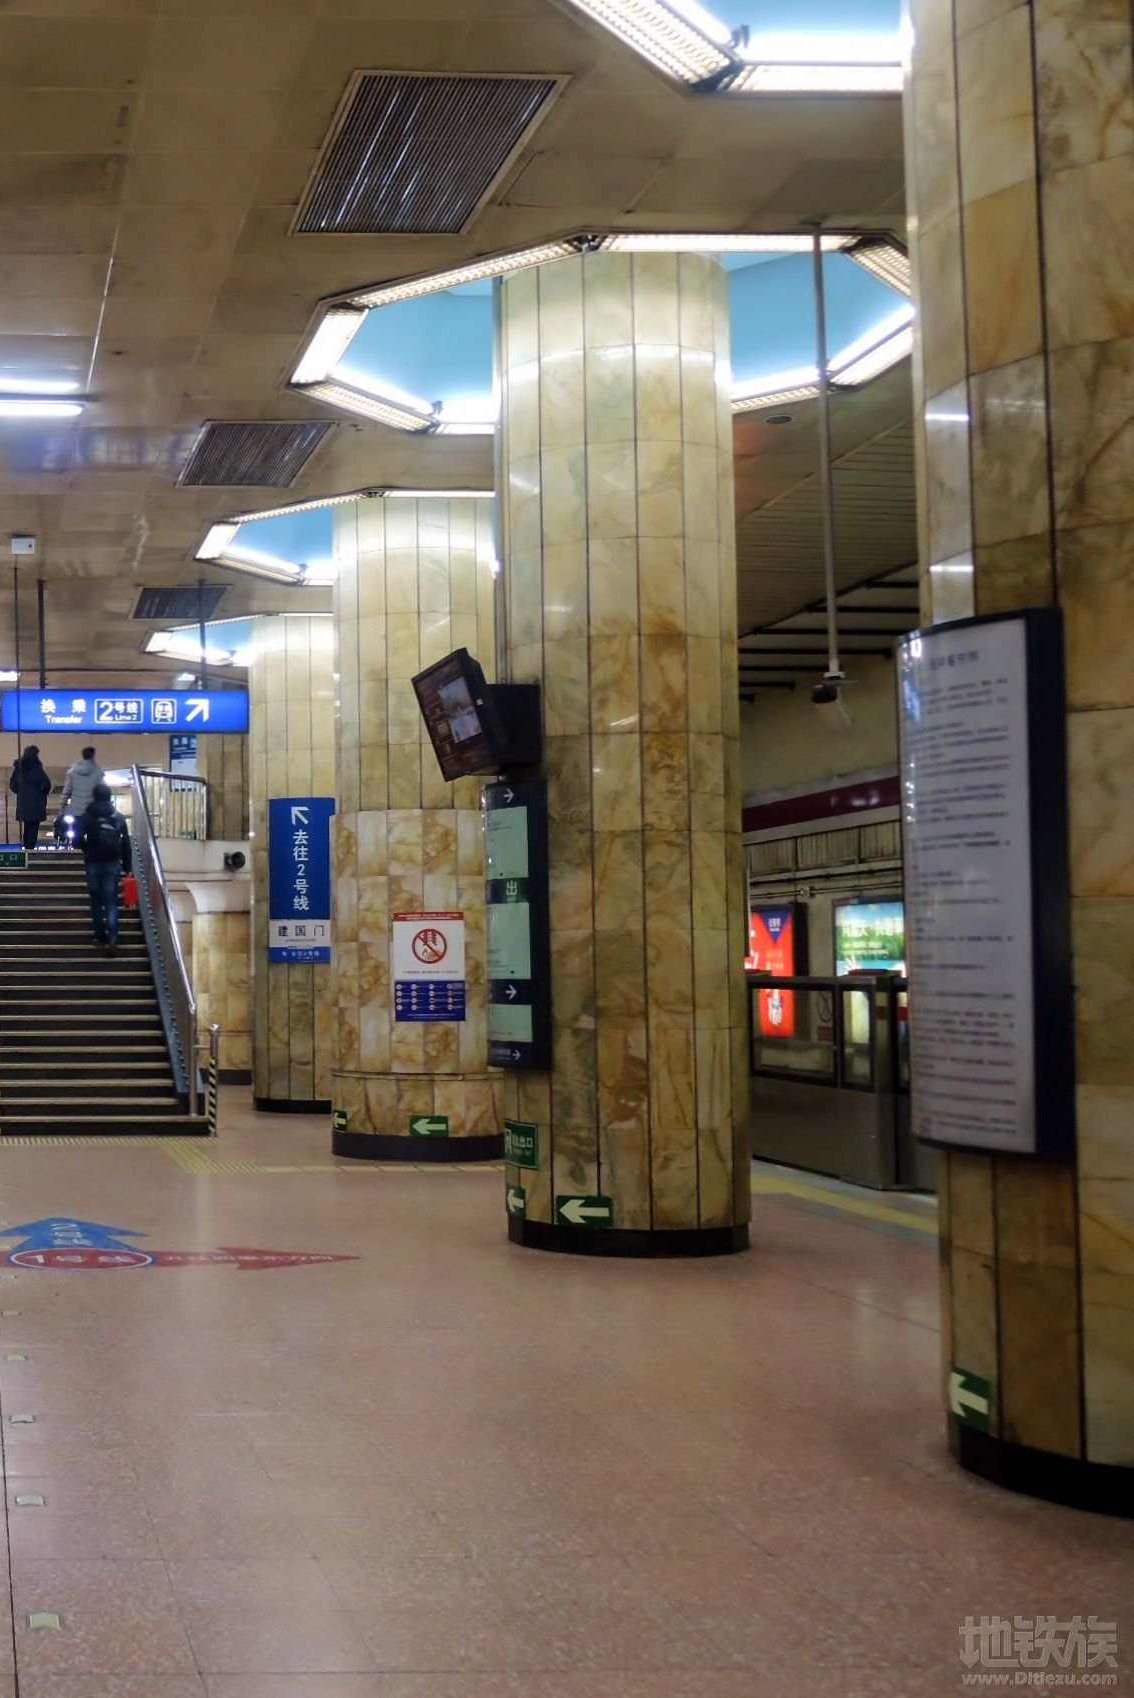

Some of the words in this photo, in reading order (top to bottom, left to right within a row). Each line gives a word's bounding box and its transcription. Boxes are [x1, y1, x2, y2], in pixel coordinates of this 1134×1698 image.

[41, 699, 86, 713] 换乘
[45, 715, 83, 724] Transfer
[115, 713, 131, 721] Line
[292, 828, 310, 911] 去往2号线
[278, 924, 324, 937] 建国门
[24, 1254, 137, 1265] 1号线
